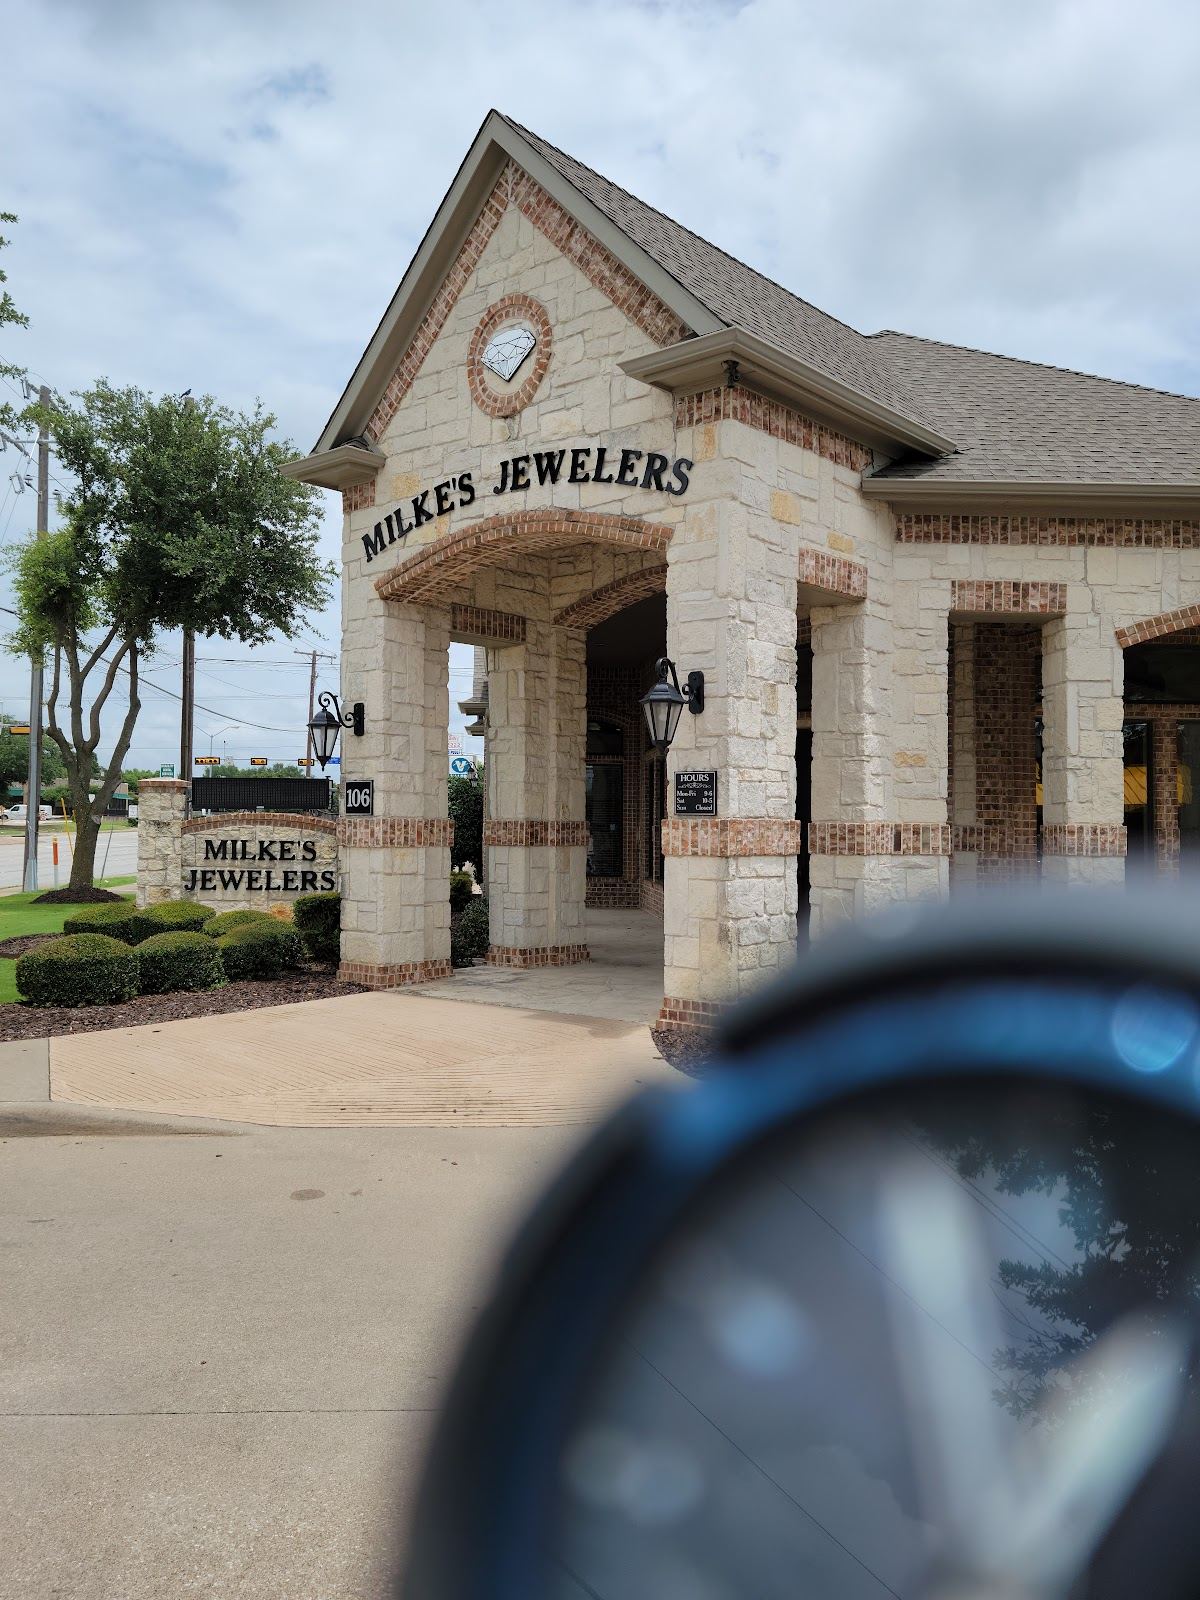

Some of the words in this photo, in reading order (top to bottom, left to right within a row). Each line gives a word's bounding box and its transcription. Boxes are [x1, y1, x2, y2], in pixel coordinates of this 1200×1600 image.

[361, 472, 477, 563] MILKE'S
[493, 447, 694, 496] JEWELERS
[680, 773, 710, 782] HOURS
[346, 788, 371, 808] 106
[204, 839, 317, 862] MILKE'S
[184, 869, 335, 892] JEWELERS
